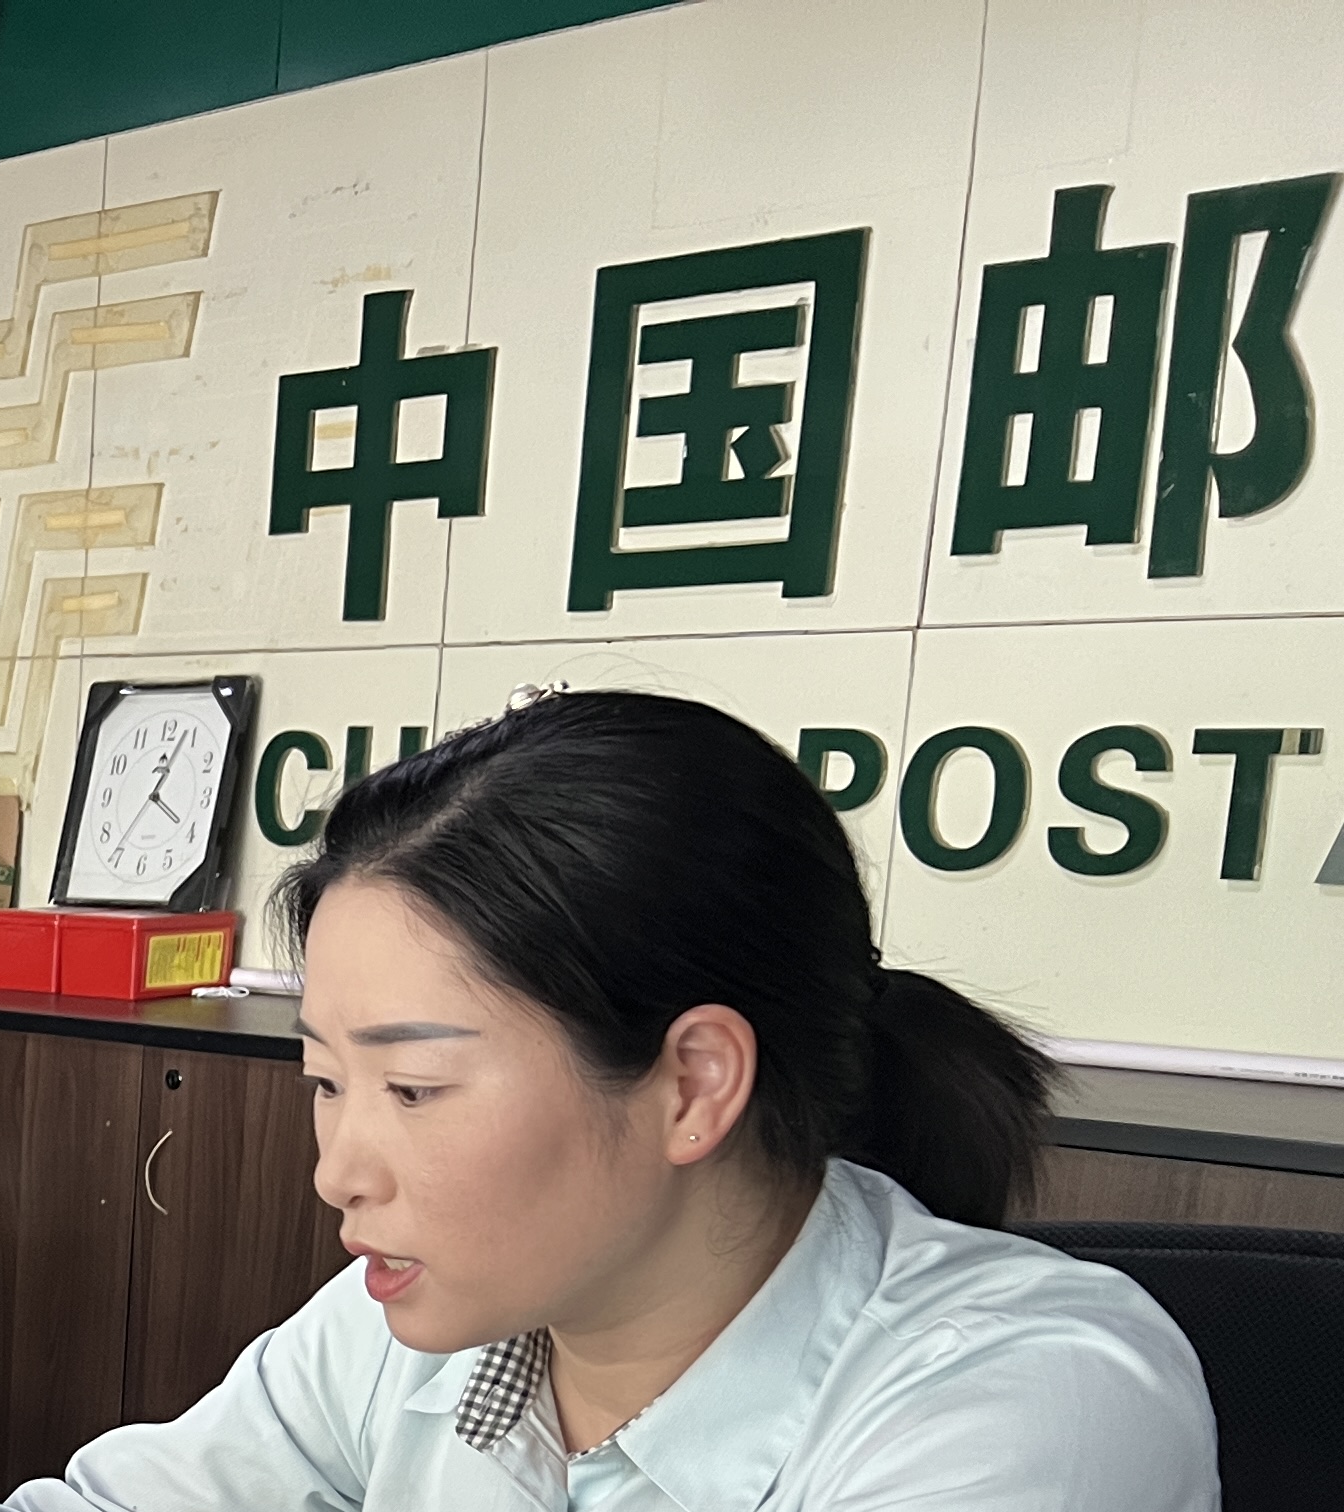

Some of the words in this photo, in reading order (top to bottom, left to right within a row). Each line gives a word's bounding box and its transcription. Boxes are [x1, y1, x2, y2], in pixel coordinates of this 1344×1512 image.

[268, 171, 1341, 622] 中国邮
[160, 719, 178, 742] 12
[109, 752, 128, 776] 10
[201, 751, 214, 774] 2
[100, 787, 113, 808] 9
[199, 786, 213, 809] 3
[796, 724, 1344, 886] POST
[99, 821, 112, 844] 8
[184, 821, 197, 844] 4
[111, 846, 125, 870] 7
[135, 854, 148, 877] 6
[161, 848, 174, 871] 5
